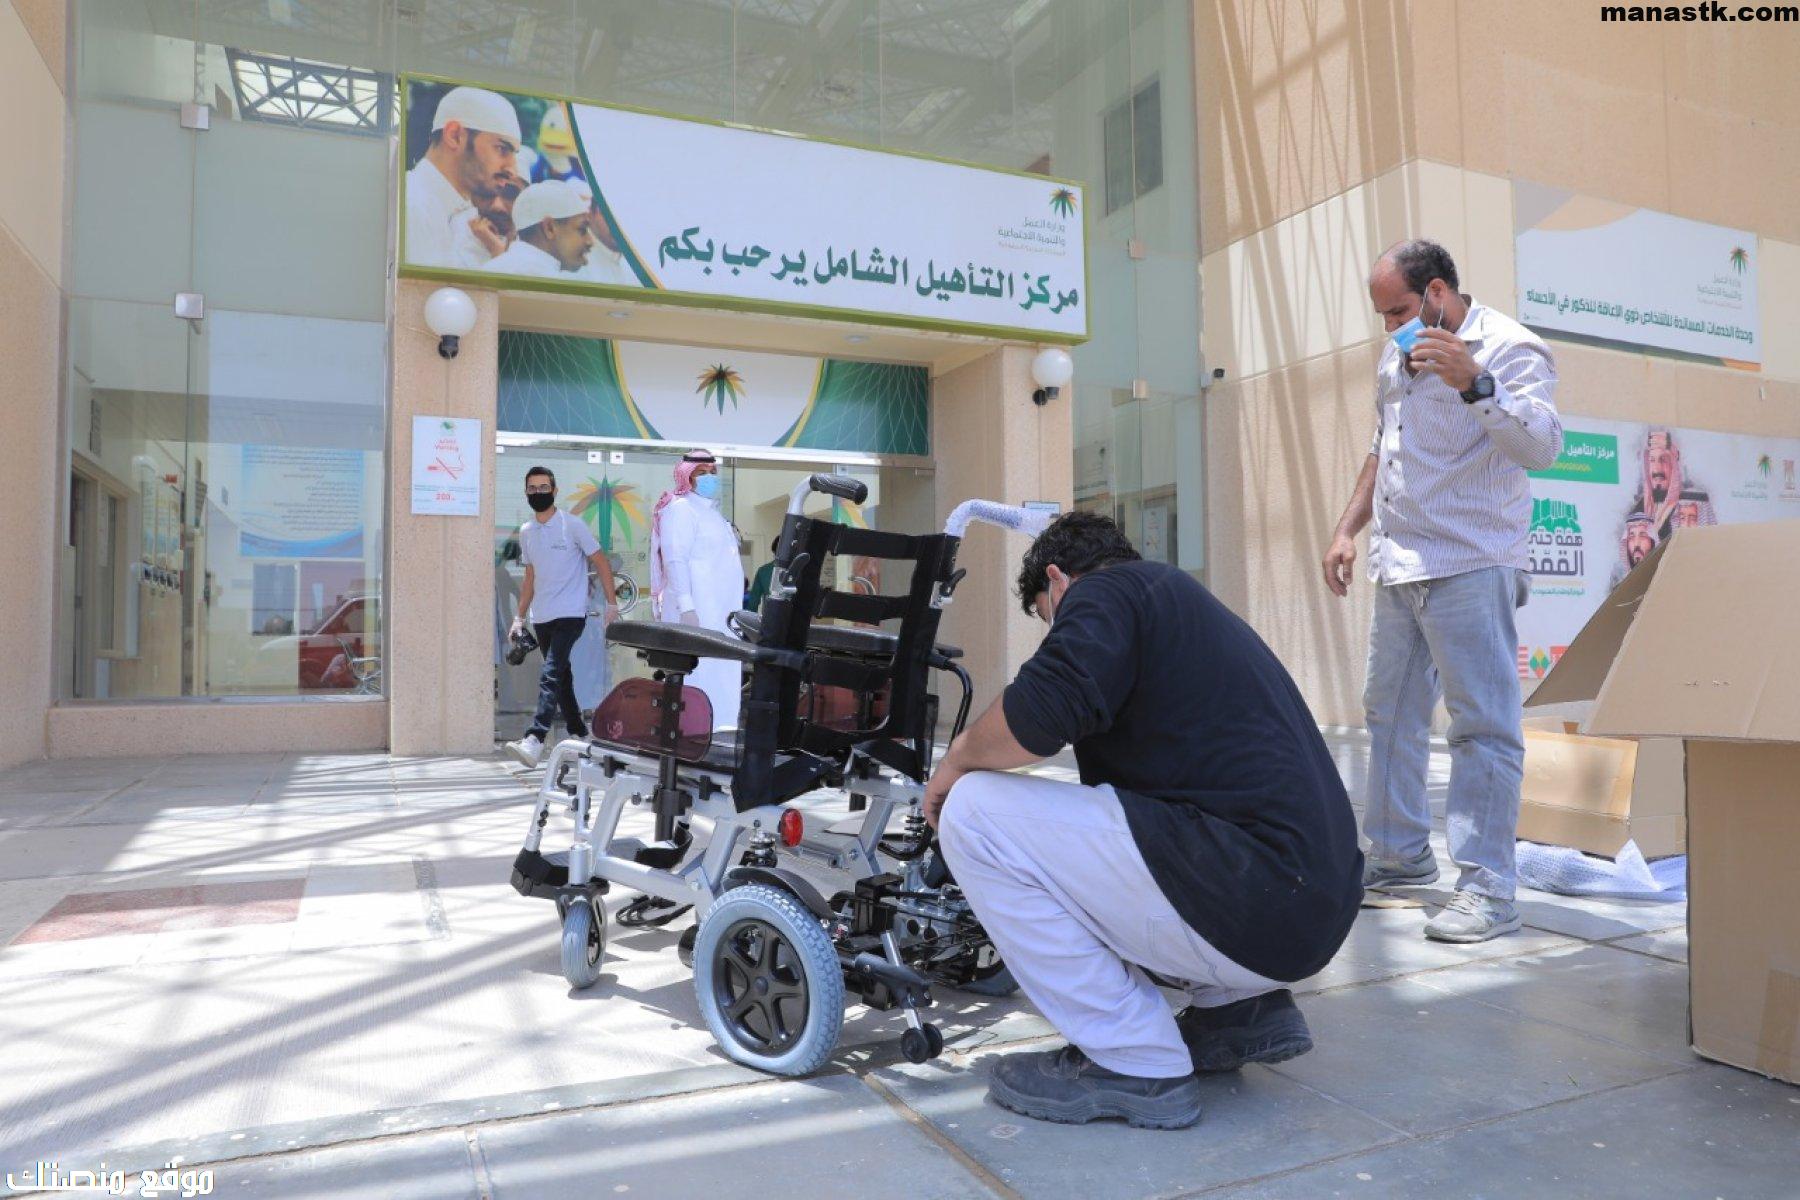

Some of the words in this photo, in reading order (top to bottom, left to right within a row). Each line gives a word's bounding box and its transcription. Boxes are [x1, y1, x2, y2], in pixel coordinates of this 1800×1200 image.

[659, 226, 714, 277] بكم
[814, 245, 908, 287] الشامل
[916, 258, 1014, 302] التأهيل
[1019, 271, 1079, 315] مركز
[1557, 294, 1569, 315] في
[1567, 442, 1597, 458] التأهيل
[1597, 446, 1615, 460] مركز
